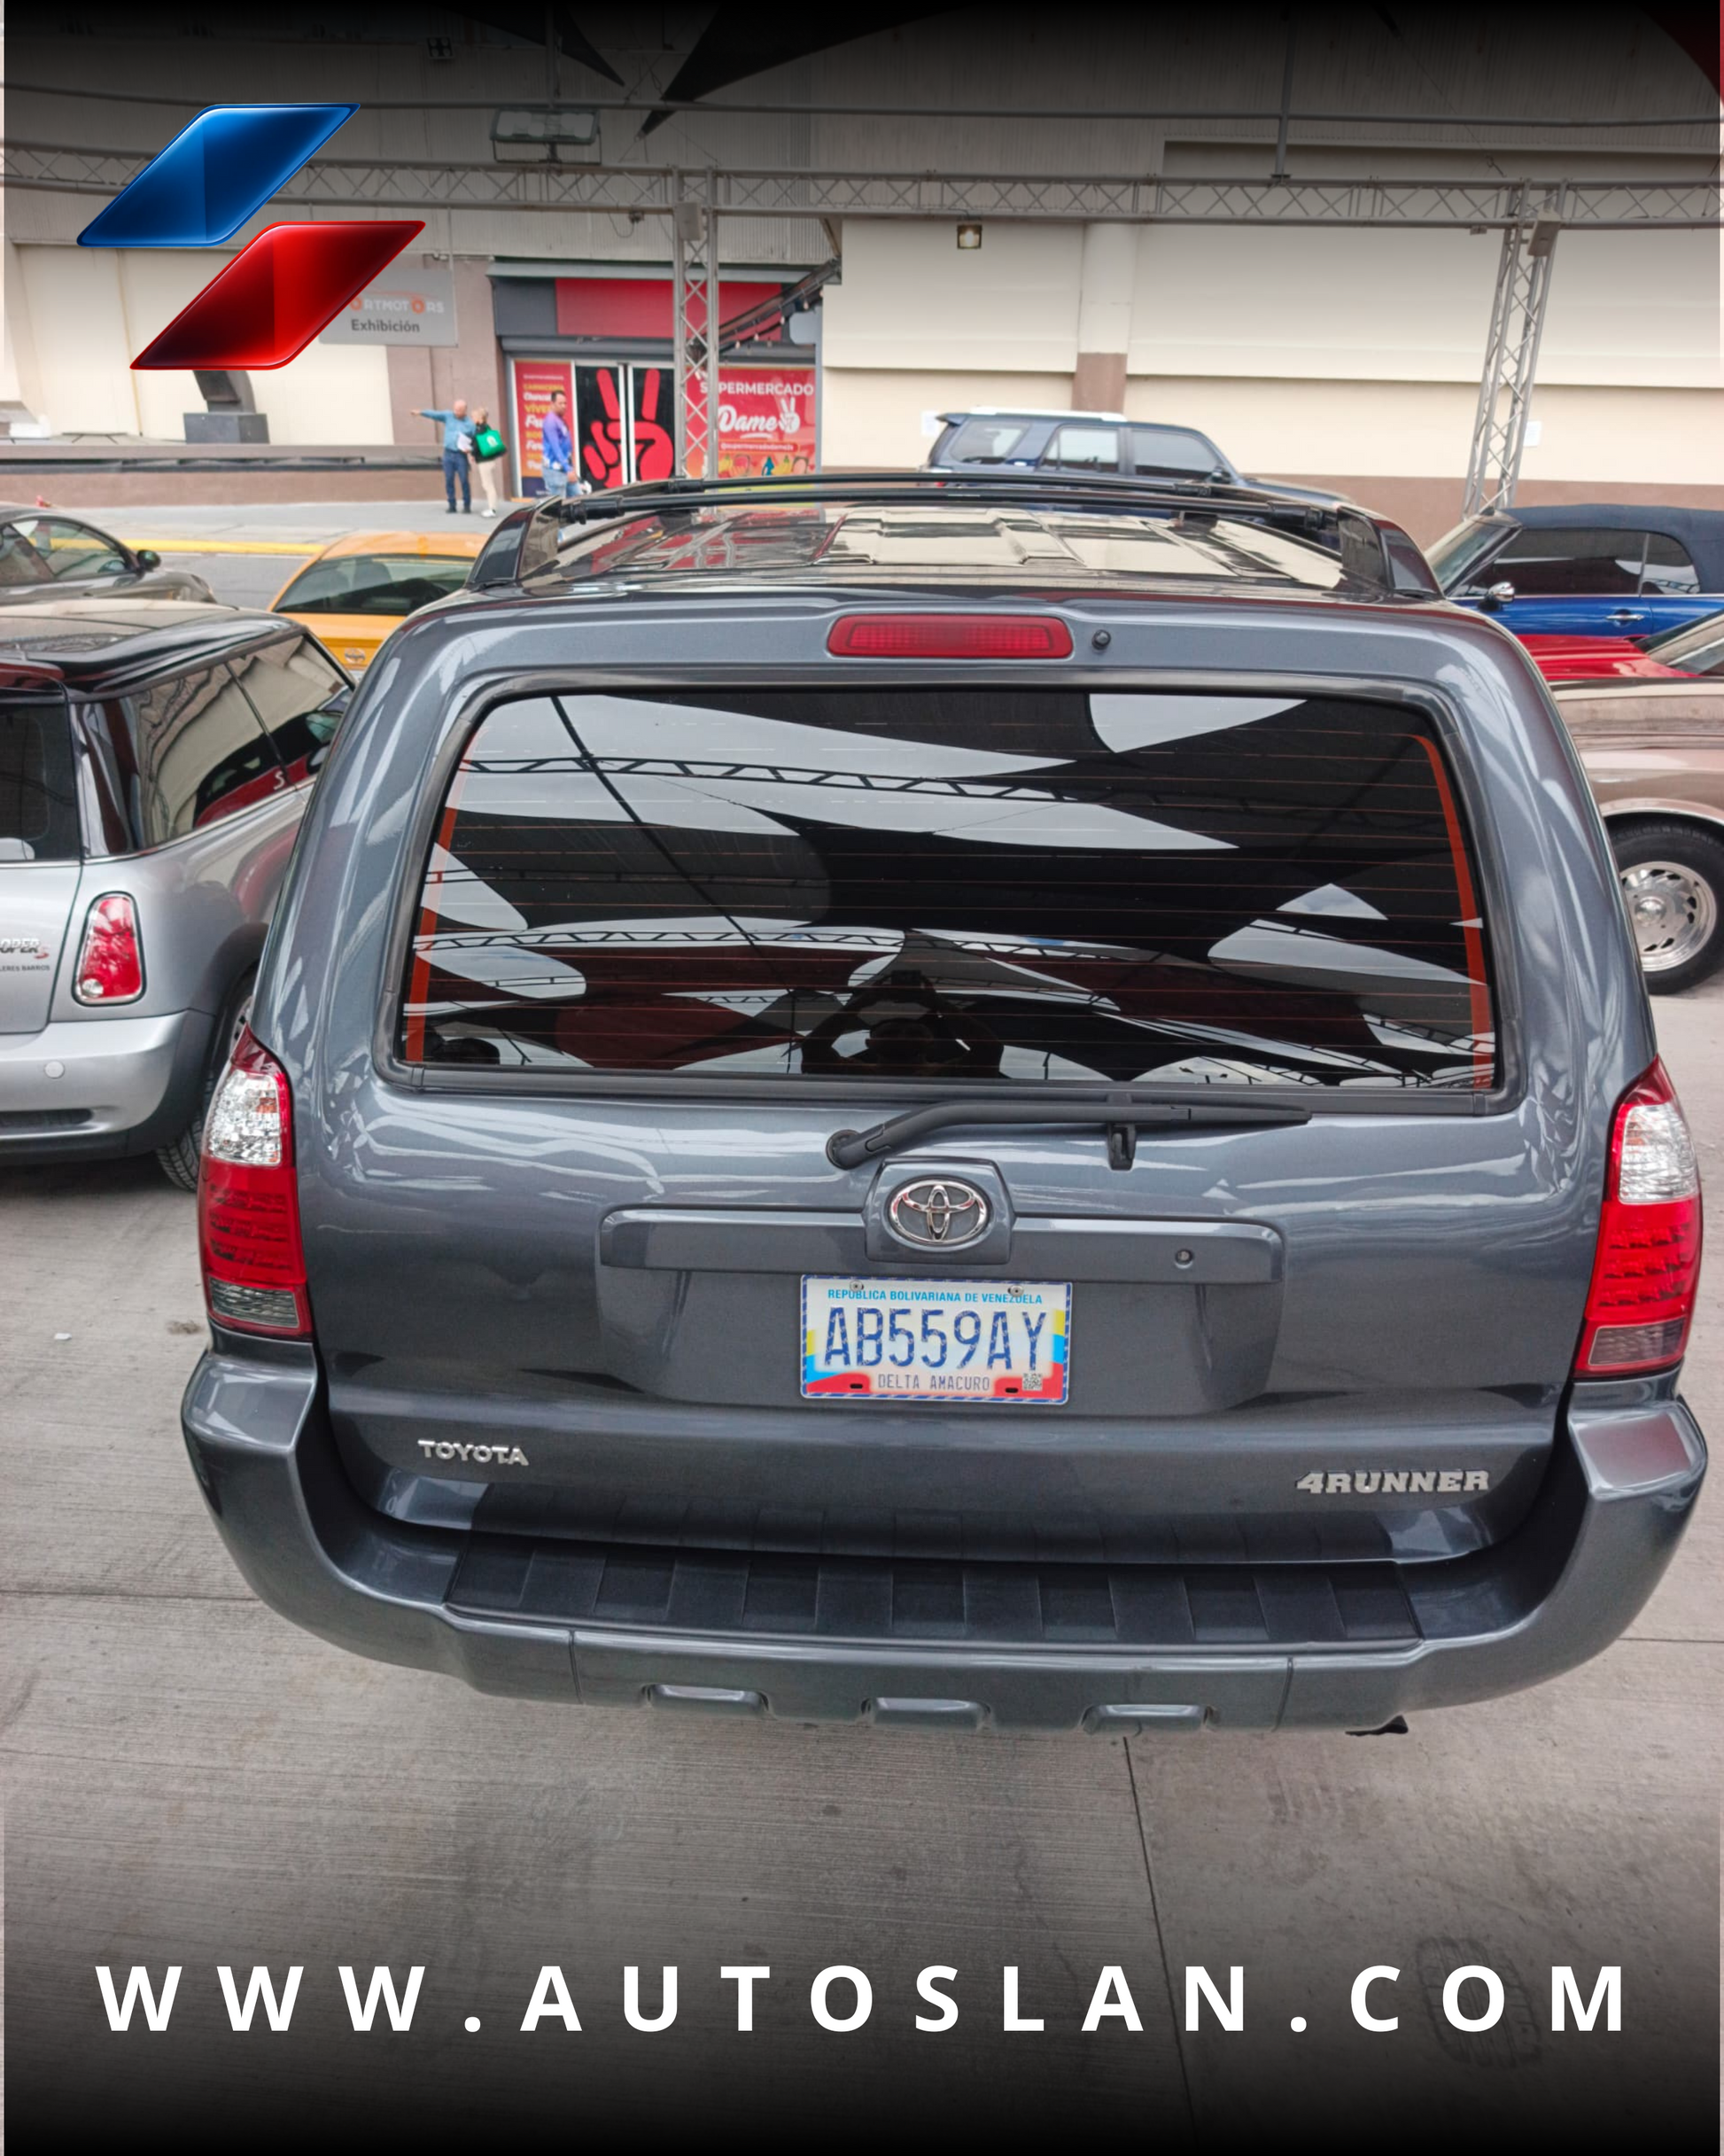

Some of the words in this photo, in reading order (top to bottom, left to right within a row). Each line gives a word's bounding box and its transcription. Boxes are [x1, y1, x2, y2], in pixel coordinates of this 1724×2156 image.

[351, 319, 421, 332] Exhibición
[700, 381, 814, 396] SPERMERCADO
[718, 405, 777, 432] Dame
[889, 1290, 961, 1302] BOLIVARIANA
[964, 1292, 979, 1303] DE
[982, 1293, 1043, 1304] VENEZUELA
[824, 1306, 1047, 1372] AB559AY
[878, 1374, 920, 1389] DELTA
[929, 1374, 990, 1391] AMACURO
[417, 1438, 530, 1467] TOYOTA
[1295, 1468, 1490, 1494] 4RUNNER
